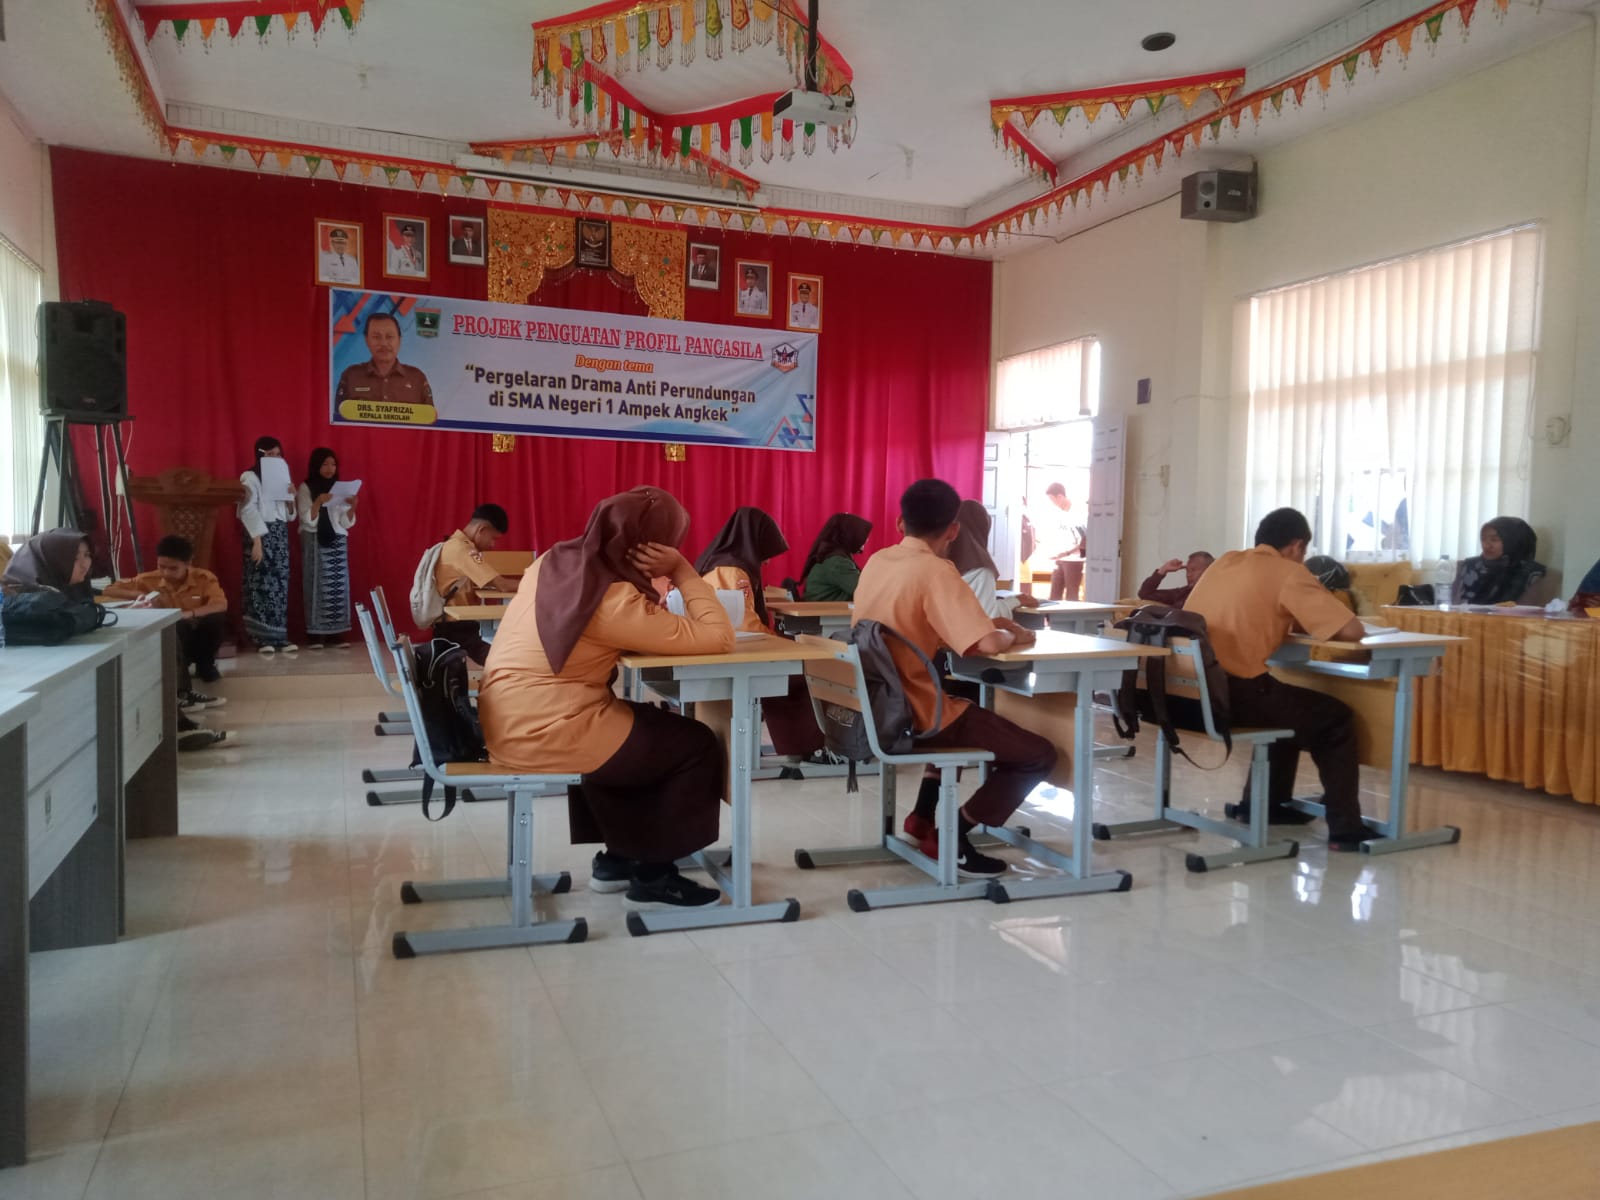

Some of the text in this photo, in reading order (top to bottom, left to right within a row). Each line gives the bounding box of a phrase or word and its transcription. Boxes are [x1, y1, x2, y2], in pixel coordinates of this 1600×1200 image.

[453, 314, 764, 361] PROJEK PENGUATAN PROFIL PANCASILA
[575, 354, 654, 373] Dengan tema
[571, 374, 622, 393] Drama
[626, 379, 656, 396] Anti
[660, 381, 756, 404] Perundungan
[375, 405, 414, 414] SYAFRIZAL
[489, 391, 504, 407] di
[508, 392, 544, 410] SMA
[549, 394, 601, 415] Negeri
[606, 399, 613, 414] 1
[618, 400, 670, 419] Ampek
